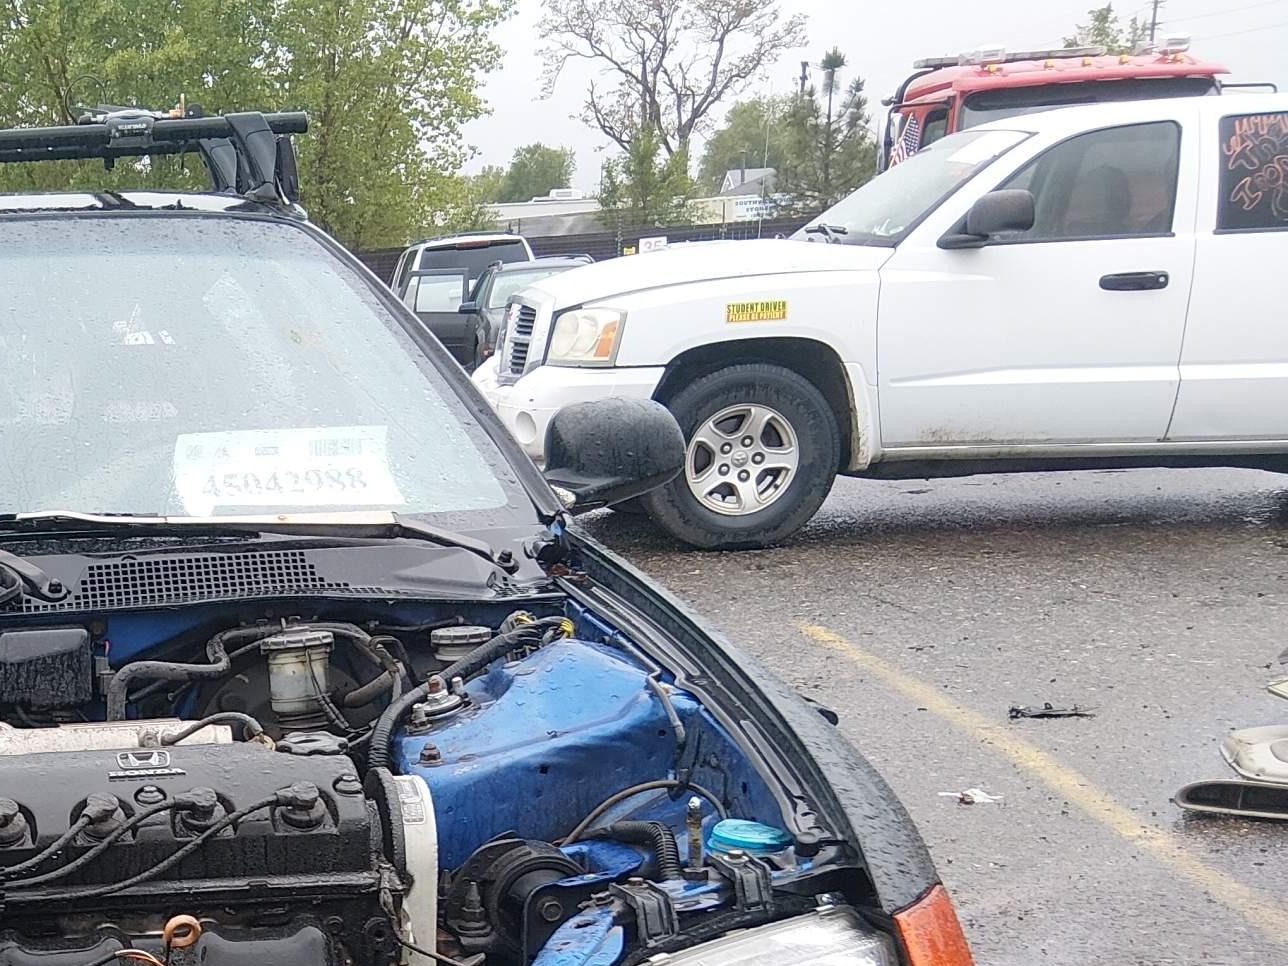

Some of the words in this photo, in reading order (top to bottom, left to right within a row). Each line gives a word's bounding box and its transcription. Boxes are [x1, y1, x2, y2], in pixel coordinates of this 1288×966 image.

[727, 303, 759, 313] STUDENT
[760, 301, 786, 312] DRIVER
[201, 467, 368, 497] 45042988
[108, 768, 187, 779] HONDA
